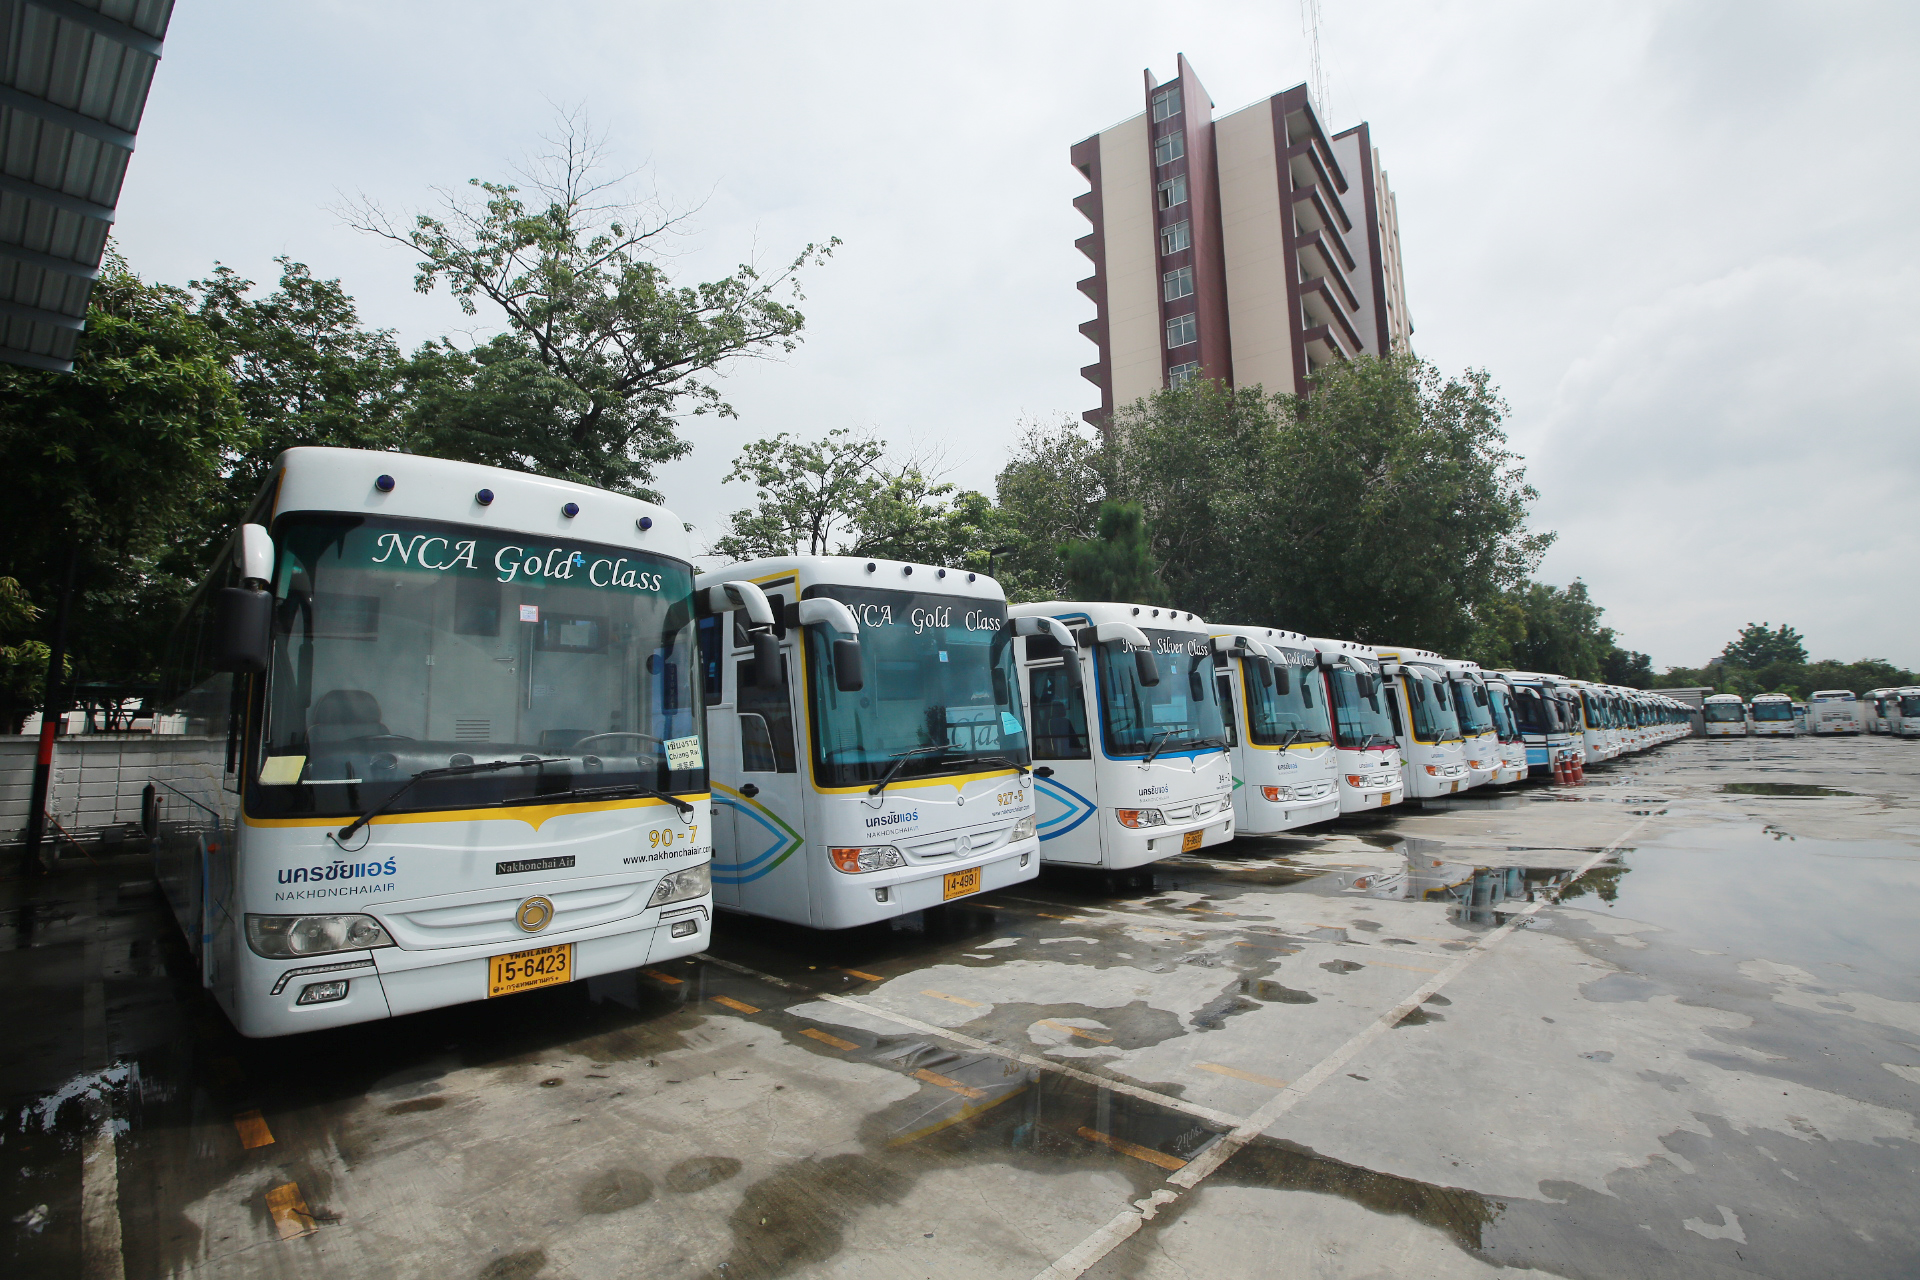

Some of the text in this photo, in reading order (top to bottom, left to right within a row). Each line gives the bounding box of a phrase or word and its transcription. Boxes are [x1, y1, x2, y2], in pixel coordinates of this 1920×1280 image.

[372, 533, 478, 570] NCA
[589, 558, 662, 592] Class
[911, 606, 952, 635] Gold
[965, 609, 1001, 632] Class
[1156, 636, 1184, 655] Silver
[1187, 638, 1209, 657] Class
[865, 808, 919, 828] นครชัยแอร์
[277, 856, 397, 884] นครชัยแอร์
[498, 857, 574, 874] Nakhonchai Air
[275, 883, 395, 901] NAKHONCHAIAIR
[947, 873, 978, 892] 14-4981
[510, 947, 553, 960] THAILAND
[497, 953, 567, 984] 15-6423
